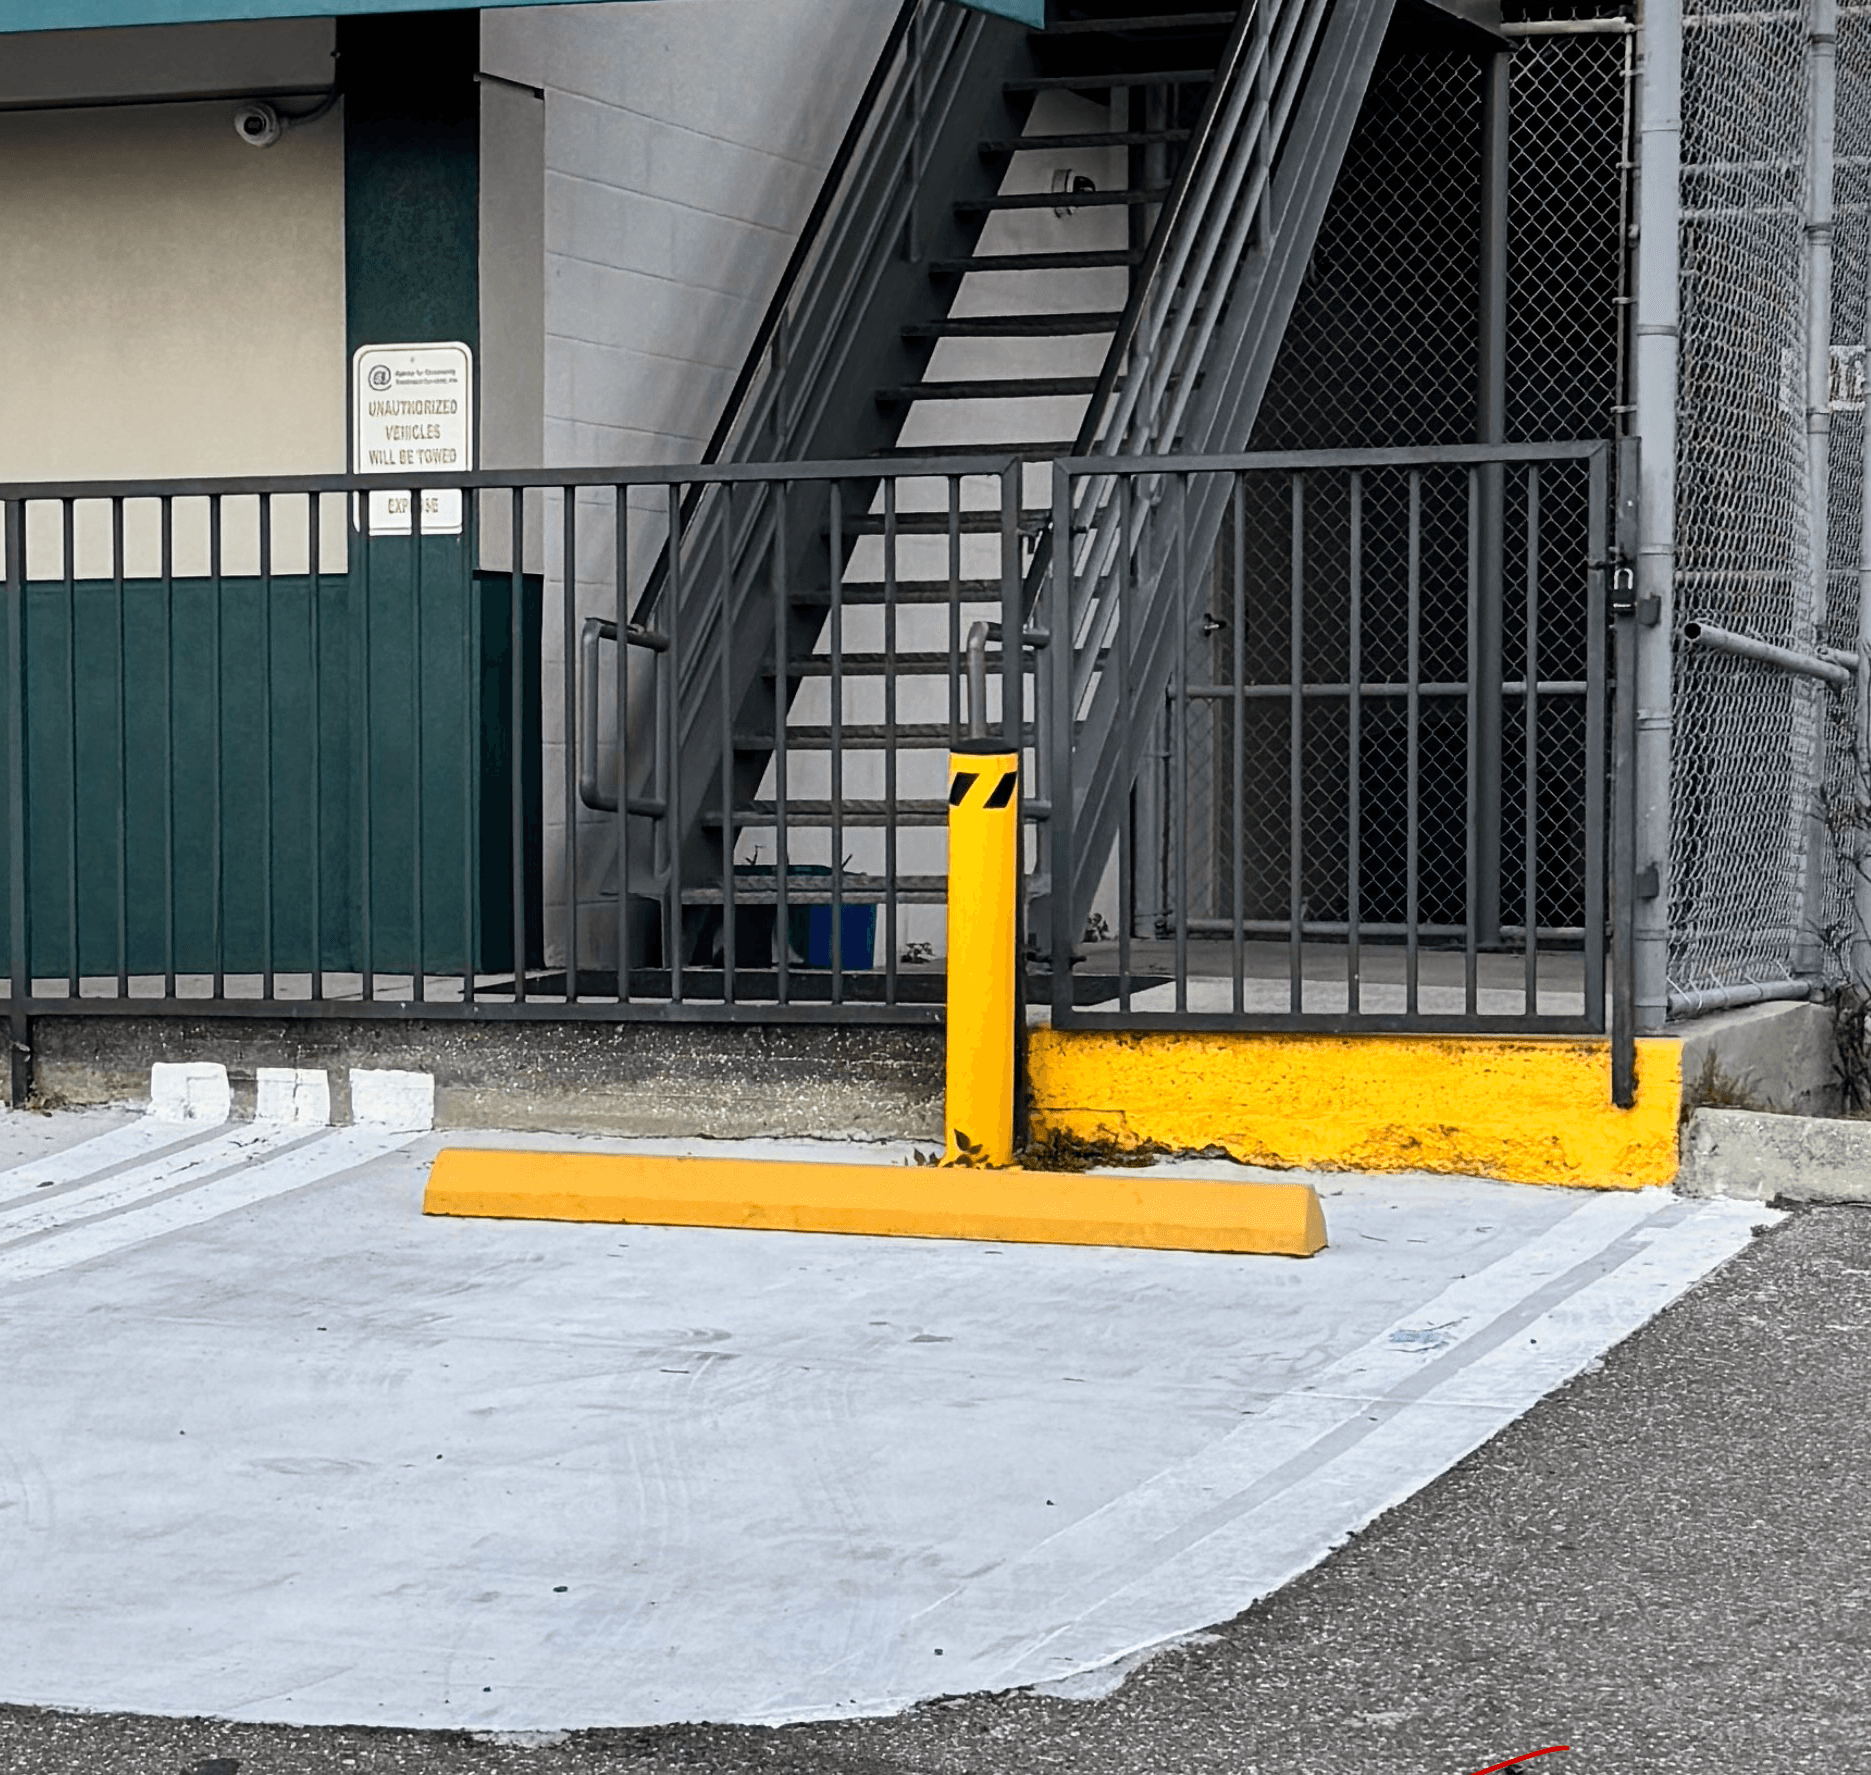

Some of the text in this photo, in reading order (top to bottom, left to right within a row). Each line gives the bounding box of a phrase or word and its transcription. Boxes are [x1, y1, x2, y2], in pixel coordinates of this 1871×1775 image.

[368, 399, 458, 417] UNAUTHORIZED
[385, 424, 441, 441] VEHICLES
[368, 448, 457, 466] WILL BE TOWED
[388, 497, 439, 514] EXPSE
